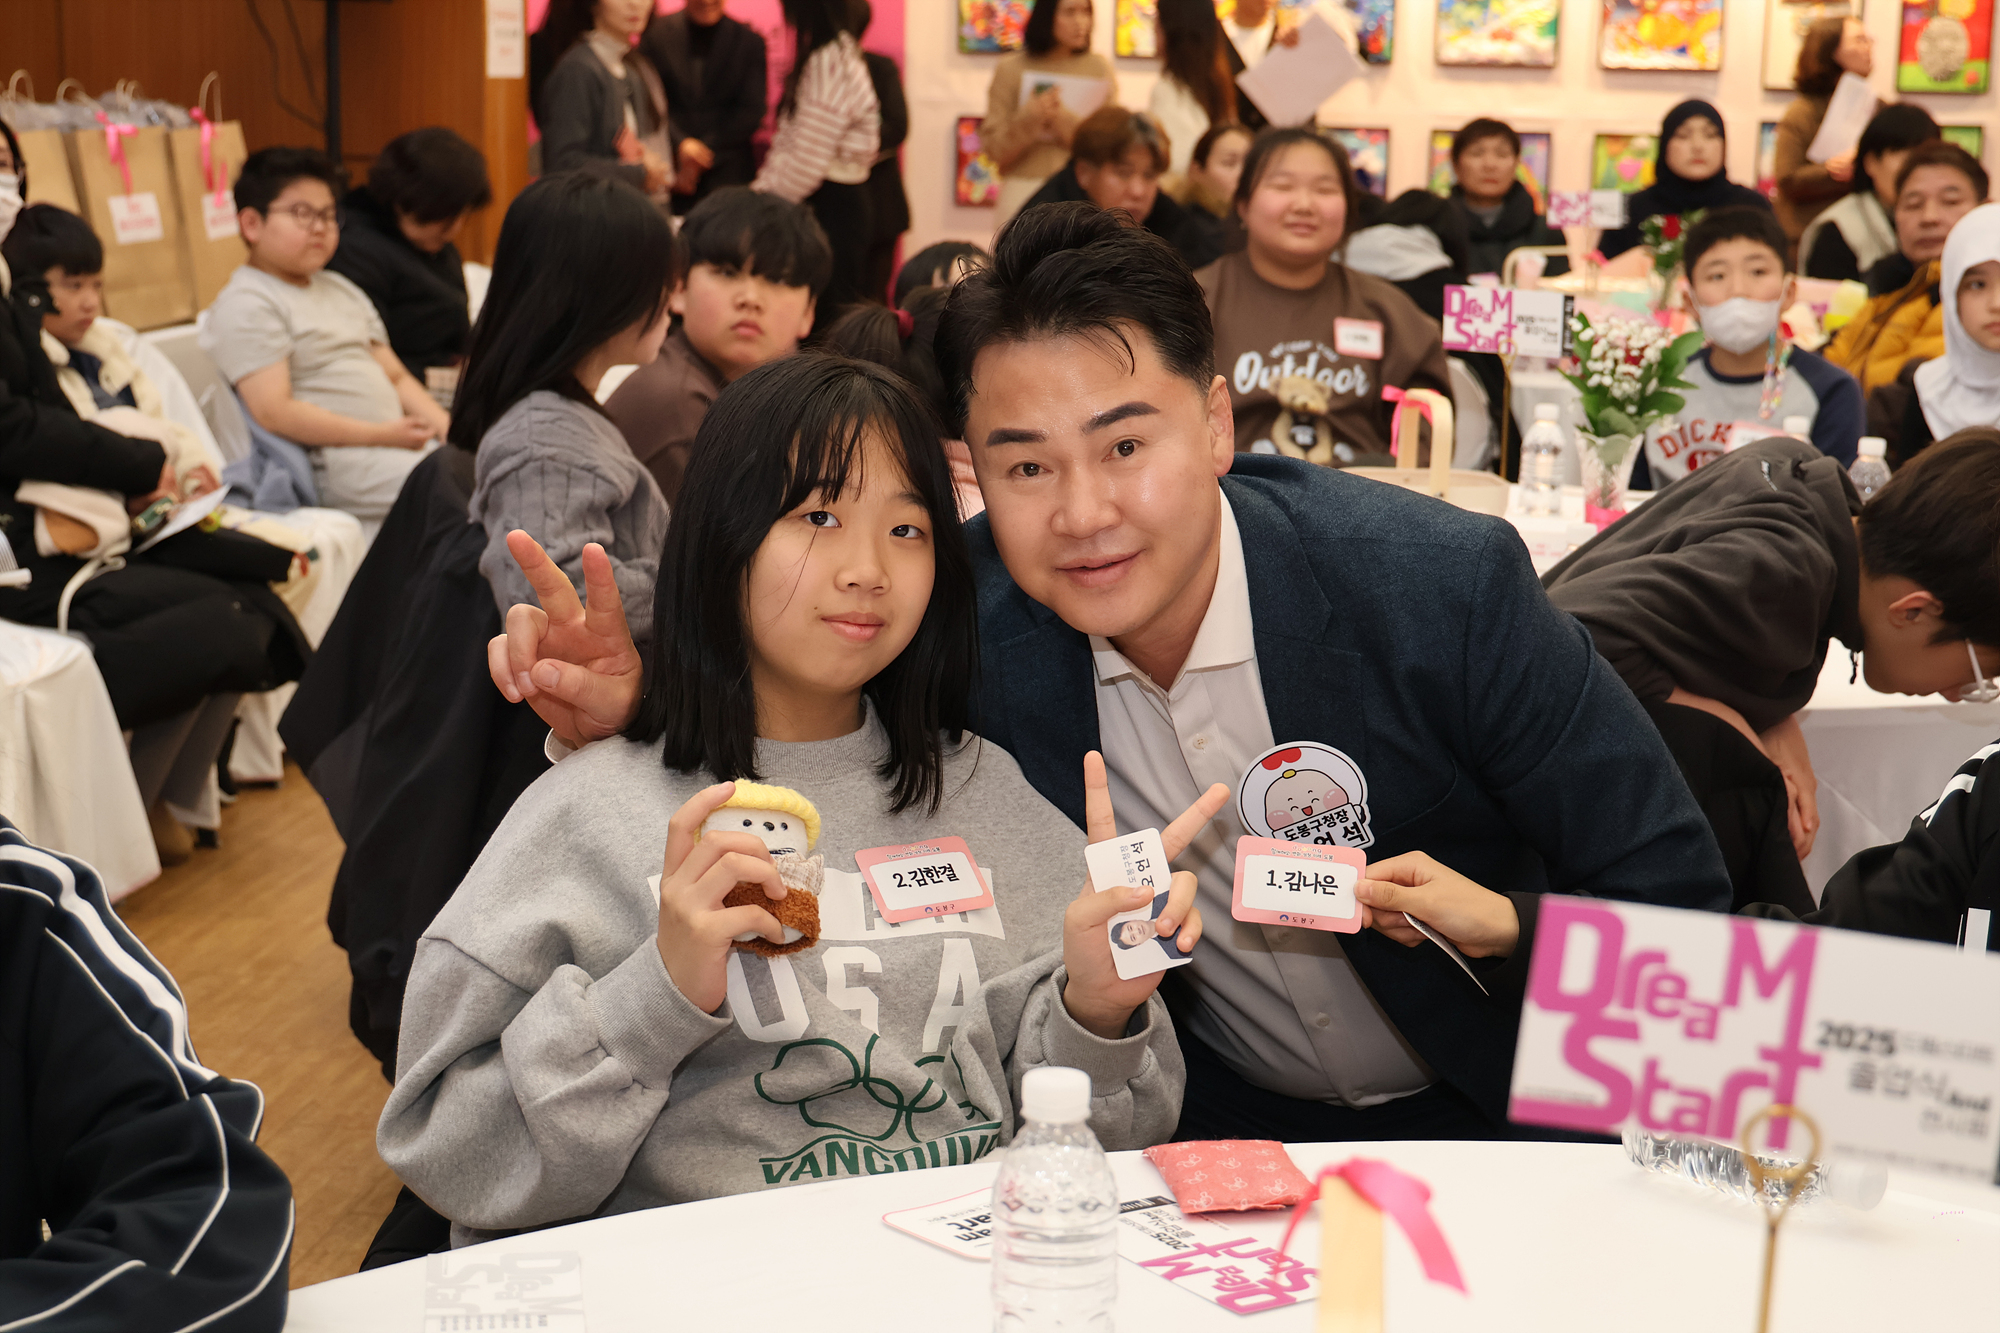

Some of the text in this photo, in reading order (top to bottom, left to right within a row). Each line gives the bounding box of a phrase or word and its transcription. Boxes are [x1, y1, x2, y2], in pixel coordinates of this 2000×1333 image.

[1233, 351, 1370, 397] Outdoor
[1284, 808, 1350, 841] 도봉구청장
[892, 863, 960, 888] 2.김한결
[1119, 845, 1137, 884] 도봉구청장
[1266, 869, 1339, 896] 1.김나은
[1292, 916, 1315, 925] 도봉구
[1526, 895, 1821, 1041] DreaM
[1508, 1008, 1824, 1151] Start
